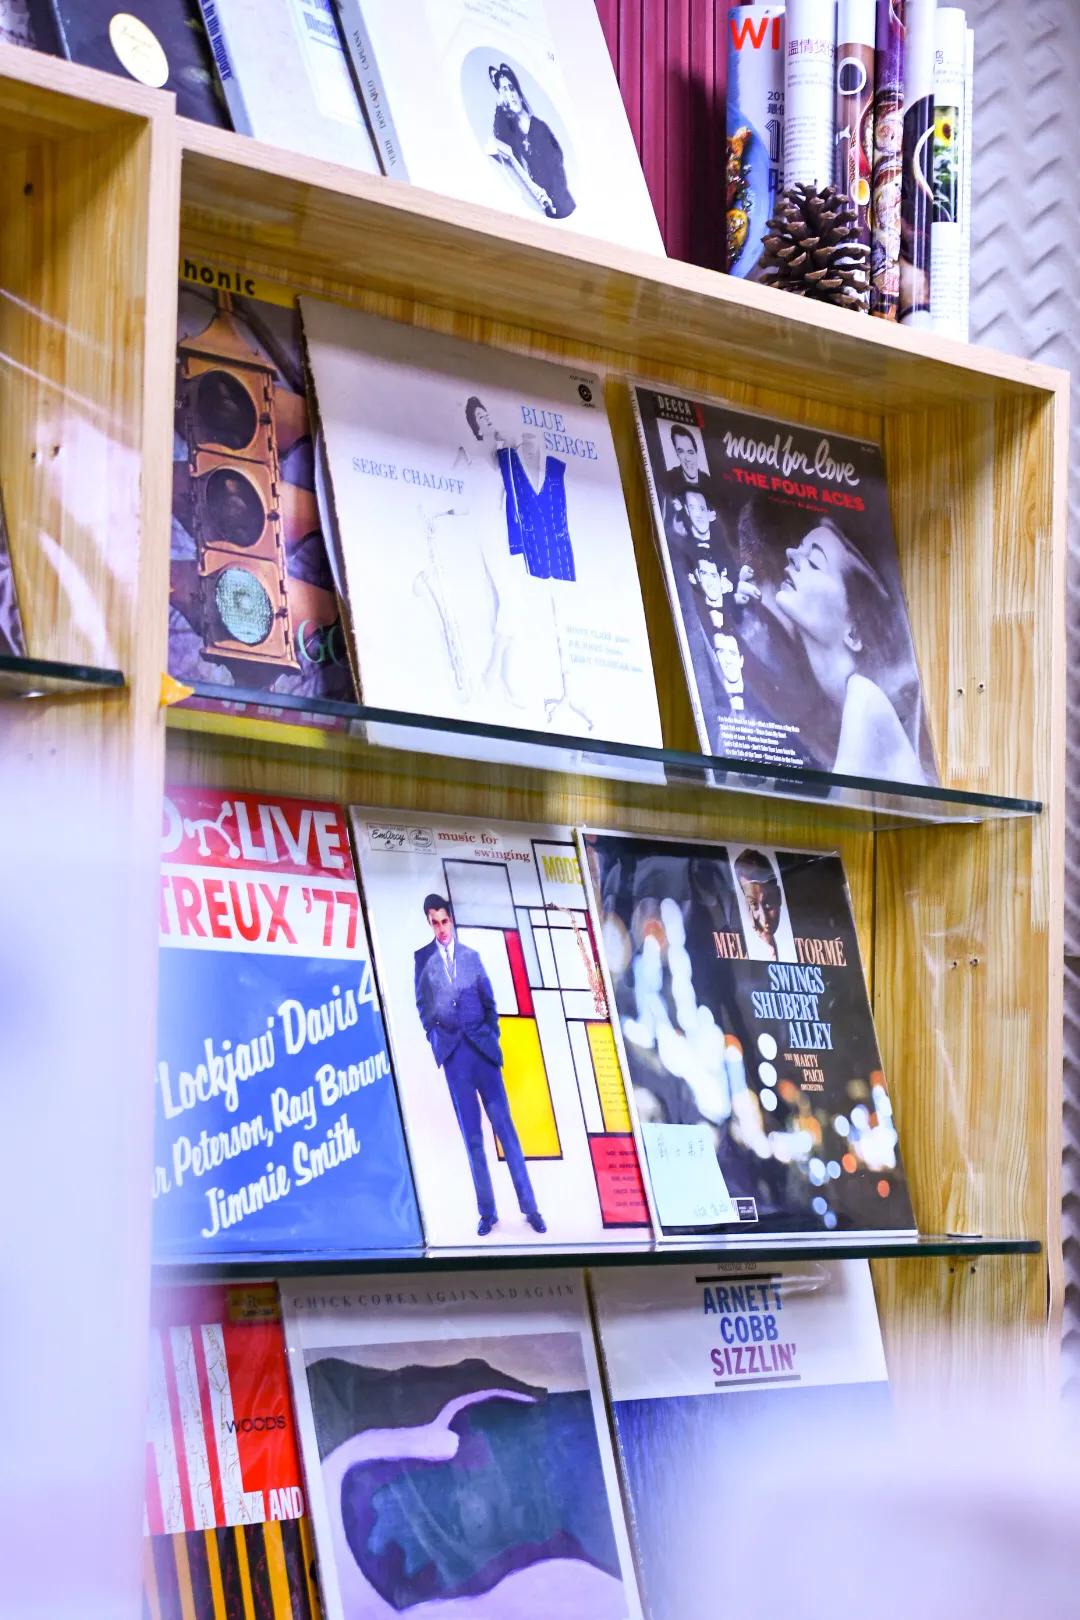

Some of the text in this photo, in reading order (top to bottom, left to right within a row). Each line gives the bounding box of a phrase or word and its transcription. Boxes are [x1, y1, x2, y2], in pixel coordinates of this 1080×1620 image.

[521, 405, 566, 433] BLUE
[658, 395, 692, 415] DECCA
[544, 431, 598, 460] SERGE
[723, 430, 860, 486] mood for love
[352, 456, 465, 495] SERGE CHALOFF
[732, 467, 769, 490] THE
[771, 476, 818, 500] FOUR
[821, 489, 865, 512] ACES
[234, 801, 344, 870] LIVE
[438, 831, 475, 843] music
[481, 833, 498, 844] for
[474, 847, 531, 863] swinging
[712, 931, 848, 966] MEL TORMÉ
[768, 963, 825, 994] SWINGS
[277, 985, 359, 1055] Davis
[751, 991, 820, 1021] SHUBERT
[788, 1021, 834, 1050] ALLEY
[793, 1053, 819, 1067] MARTY
[173, 1114, 274, 1187] Peterson,
[270, 1086, 318, 1134] Ray
[202, 1113, 361, 1239] Jimmie Smith
[293, 1295, 352, 1309] CHICK
[358, 1293, 418, 1307] COREA
[703, 1283, 783, 1315] ARNETT
[720, 1314, 779, 1345] COBB
[710, 1343, 797, 1377] SIZZLIN'
[226, 1415, 287, 1434] WOODS
[268, 1486, 305, 1522] AND
